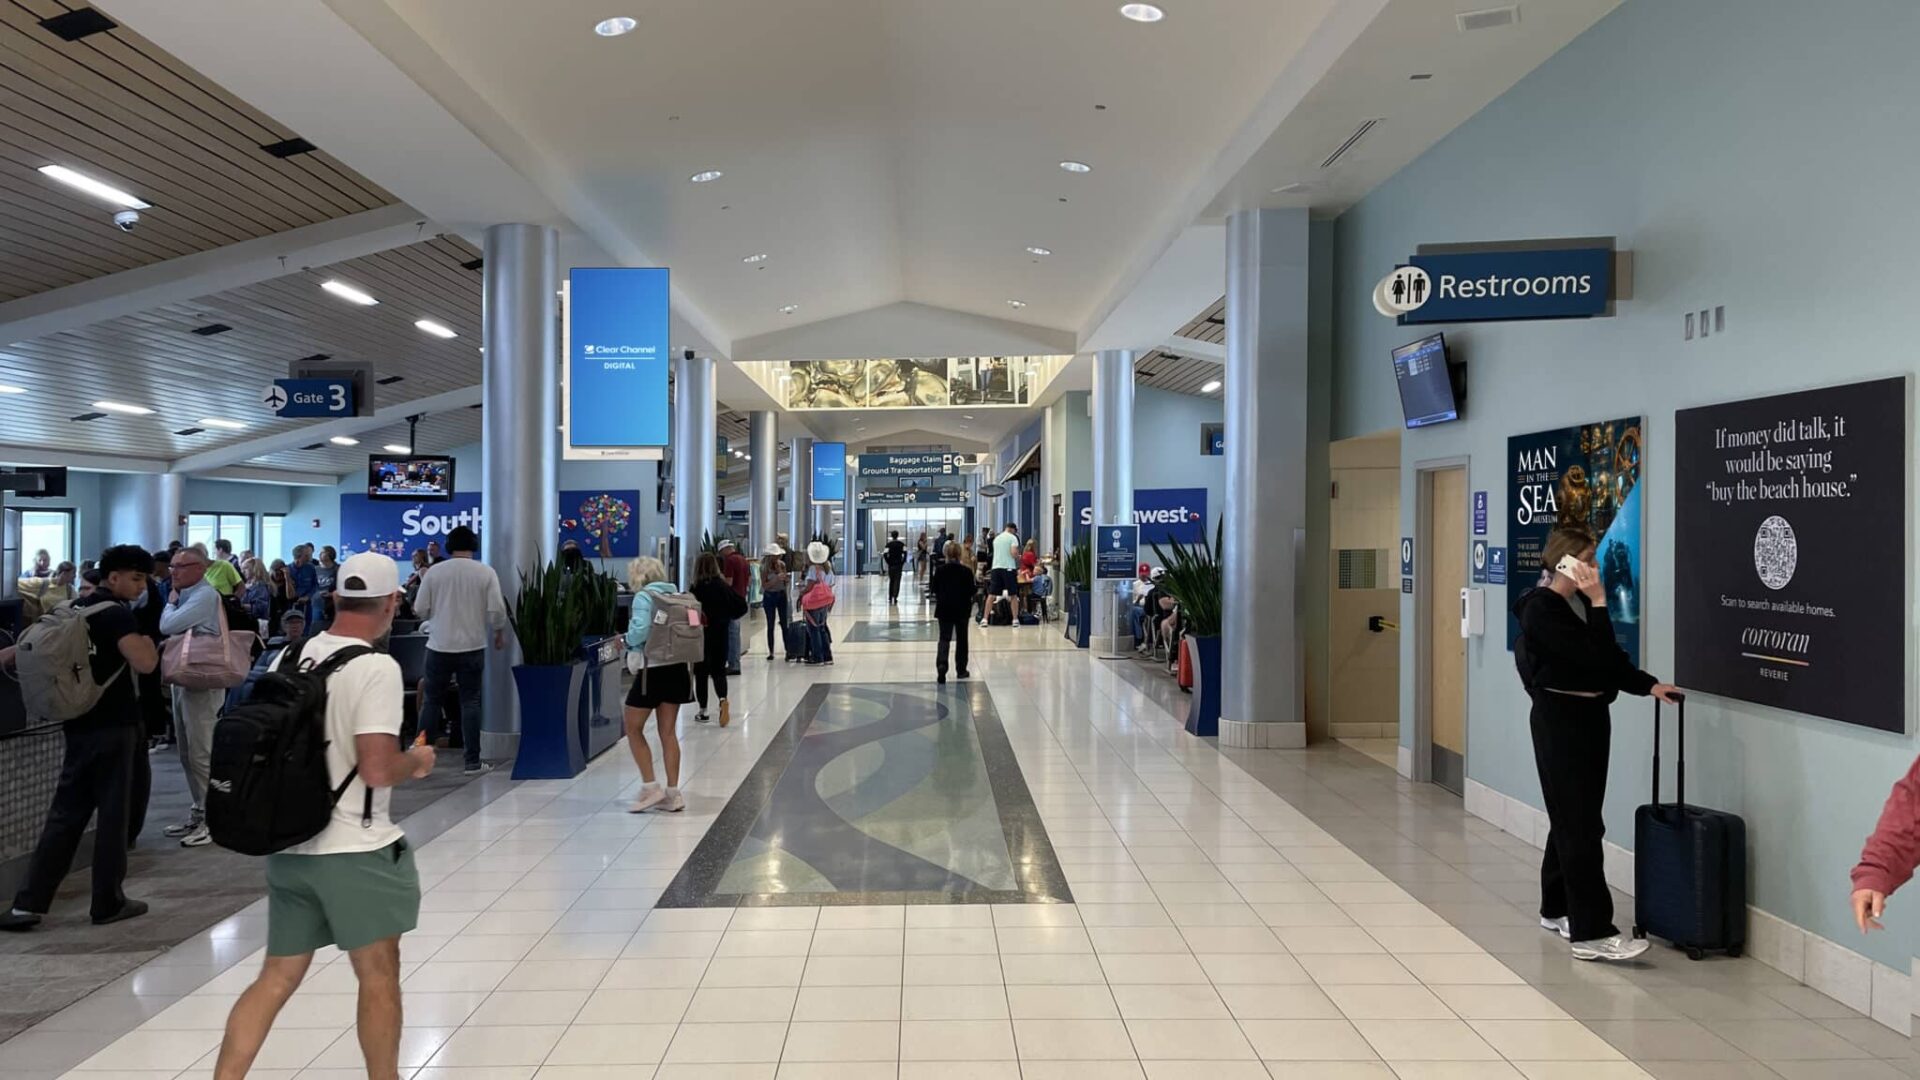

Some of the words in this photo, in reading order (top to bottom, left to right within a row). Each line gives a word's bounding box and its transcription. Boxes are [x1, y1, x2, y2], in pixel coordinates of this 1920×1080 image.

[1439, 274, 1591, 299] Restrooms
[595, 345, 619, 354] Clear
[620, 345, 656, 354] Channel
[604, 362, 636, 370] DIGITAL
[293, 392, 324, 404] Gate
[328, 384, 346, 411] 3
[1715, 427, 1727, 449] If
[1728, 428, 1771, 450] money
[1773, 419, 1796, 443] did
[1800, 416, 1831, 441] talk,
[1834, 415, 1846, 437] it
[862, 467, 889, 475] Ground
[890, 466, 942, 475] Transportation
[889, 456, 920, 465] Baggage
[922, 455, 942, 463] Claim
[1517, 446, 1557, 472] MAN
[1725, 450, 1764, 474] would
[1767, 450, 1783, 471] be
[1786, 447, 1832, 475] saying
[1526, 474, 1534, 483] IN
[1536, 472, 1549, 482] THE
[1706, 480, 1734, 506] “buy
[1737, 479, 1757, 500] the
[1760, 475, 1799, 500] beach
[1803, 473, 1858, 498] house.”
[1517, 483, 1559, 525] SEA
[1532, 514, 1558, 524] MUSEUM
[1721, 594, 1737, 607] Scan
[1738, 599, 1746, 608] to
[1747, 598, 1770, 610] search
[1771, 601, 1805, 614] available
[1806, 602, 1836, 617] homes.
[1741, 627, 1810, 654] corcoran
[1760, 667, 1789, 681] REVERIE
